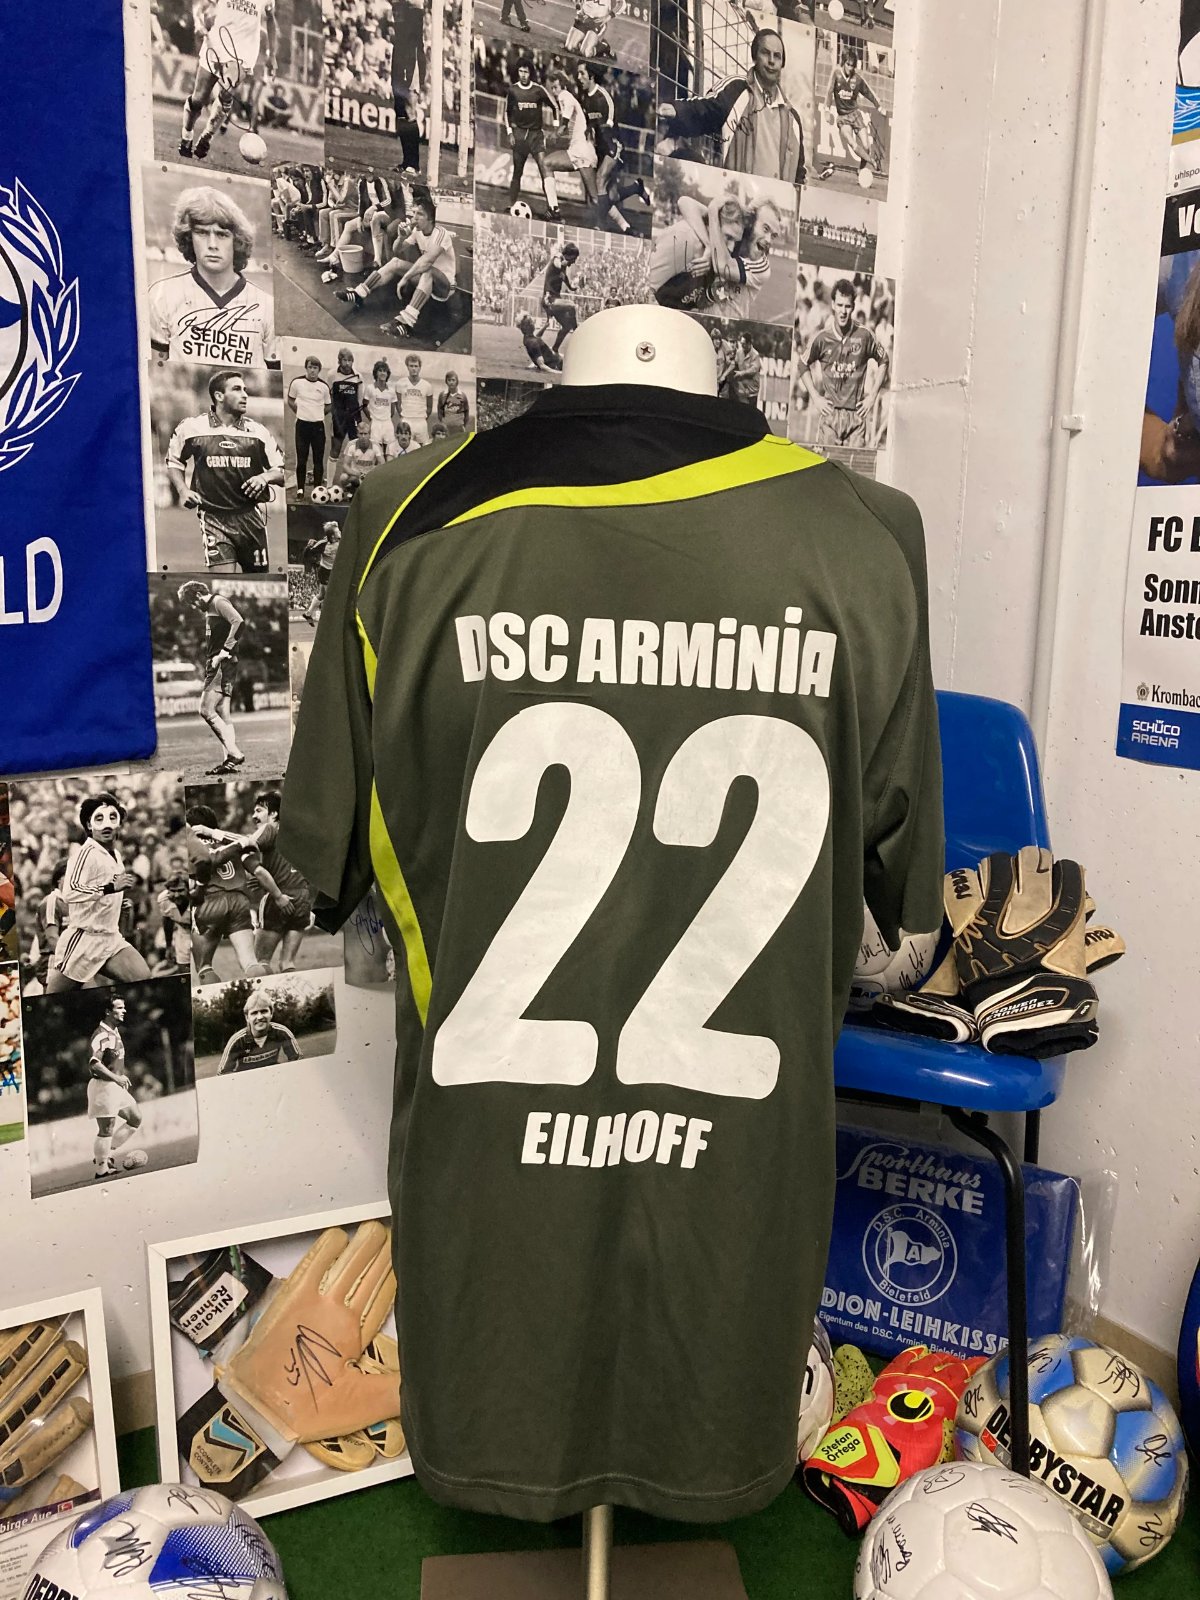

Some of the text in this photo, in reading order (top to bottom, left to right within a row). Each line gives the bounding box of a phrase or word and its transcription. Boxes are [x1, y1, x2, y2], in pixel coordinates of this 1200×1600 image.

[183, 341, 253, 364] STICKER
[190, 327, 249, 350] SEIDEN
[206, 455, 251, 468] GERRY WEBER
[1148, 516, 1183, 552] FC
[253, 548, 268, 566] 11
[0, 536, 63, 625] LD
[455, 611, 569, 682] DSC
[1131, 732, 1179, 748] ARENA
[432, 702, 830, 1100] 22
[521, 1110, 712, 1169] EILHOFF
[836, 1143, 981, 1188] Sporthaus
[858, 1166, 985, 1215] BERKE
[916, 1210, 950, 1248] Arminia
[905, 1245, 920, 1261] A
[879, 1279, 931, 1302] Bielefeld
[182, 1285, 228, 1328] Rehnen
[191, 1293, 234, 1336] Nikolai
[818, 1311, 853, 1328] Eigentum
[854, 1322, 868, 1333] des
[821, 1432, 853, 1455] Stefan
[827, 1438, 860, 1462] Ortega
[985, 1403, 1125, 1528] DEBYSTAR
[31, 1511, 52, 1524] Aue
